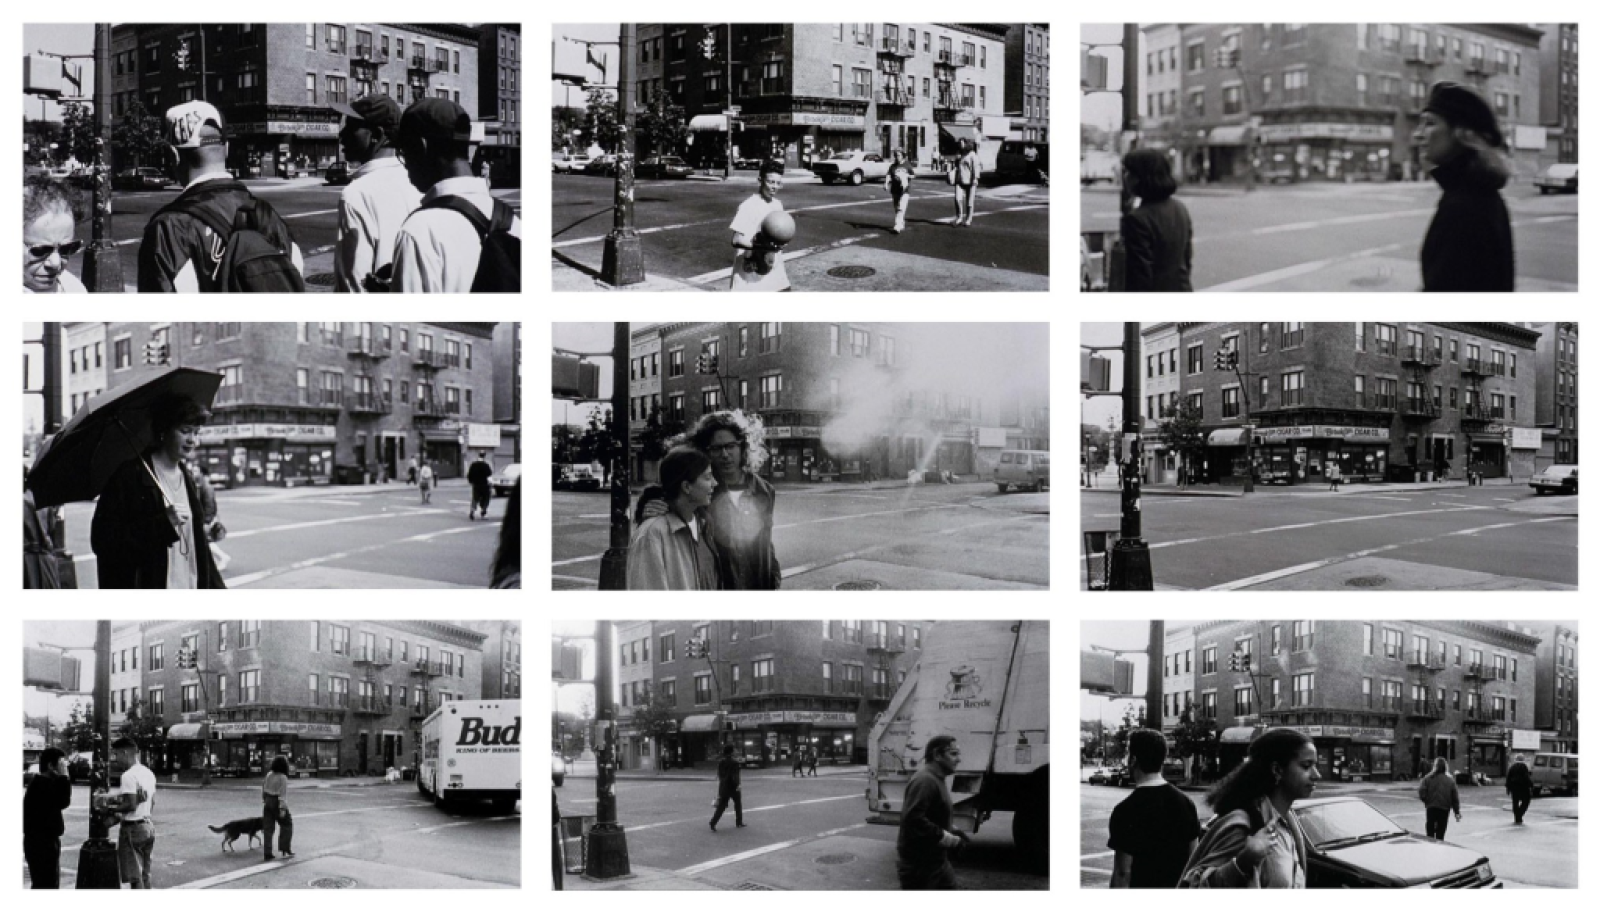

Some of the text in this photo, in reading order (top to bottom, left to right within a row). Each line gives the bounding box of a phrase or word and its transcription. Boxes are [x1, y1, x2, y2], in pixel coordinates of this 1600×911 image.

[938, 699, 991, 710] Please Recycle
[455, 716, 522, 746] Bud
